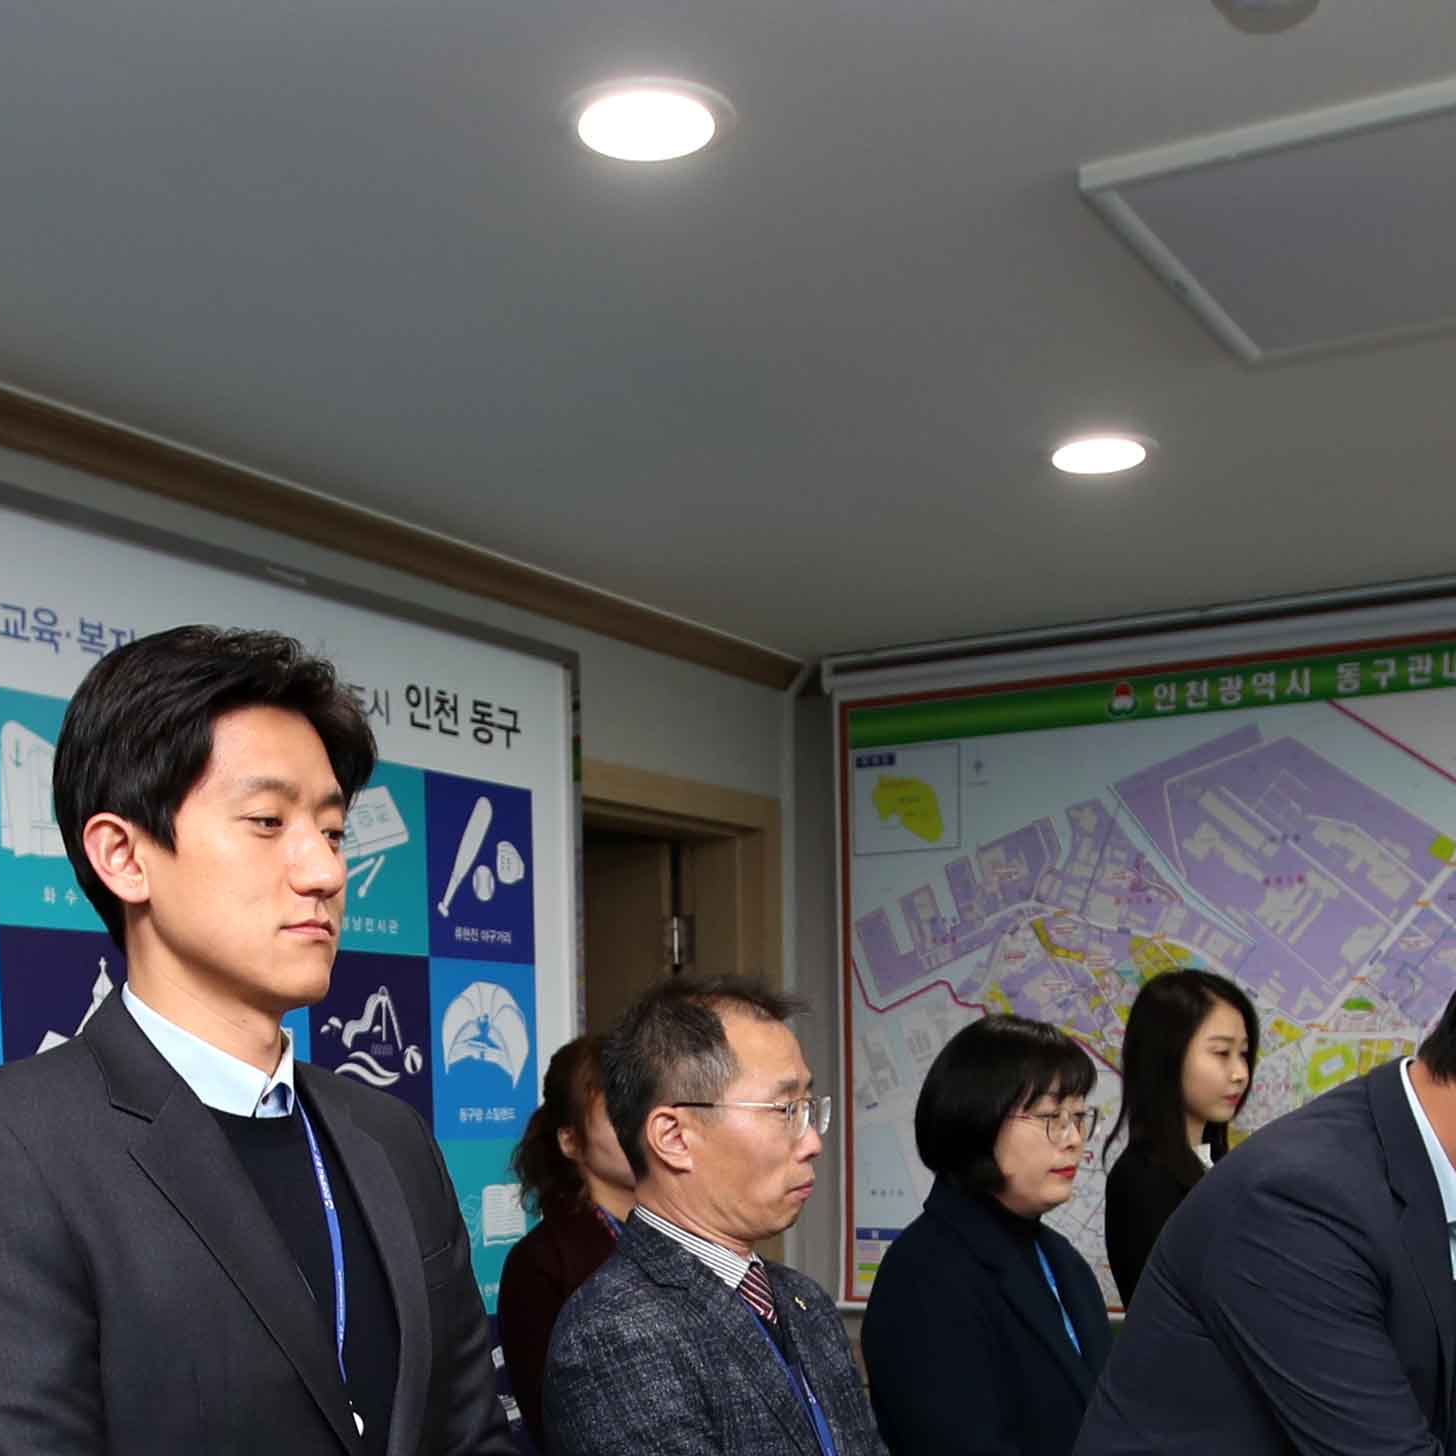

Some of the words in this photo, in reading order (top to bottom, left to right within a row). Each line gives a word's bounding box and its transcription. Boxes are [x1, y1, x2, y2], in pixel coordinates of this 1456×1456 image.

[1152, 666, 1311, 711] 인천광역시
[405, 684, 460, 737] 인천
[470, 699, 521, 749] 동구
